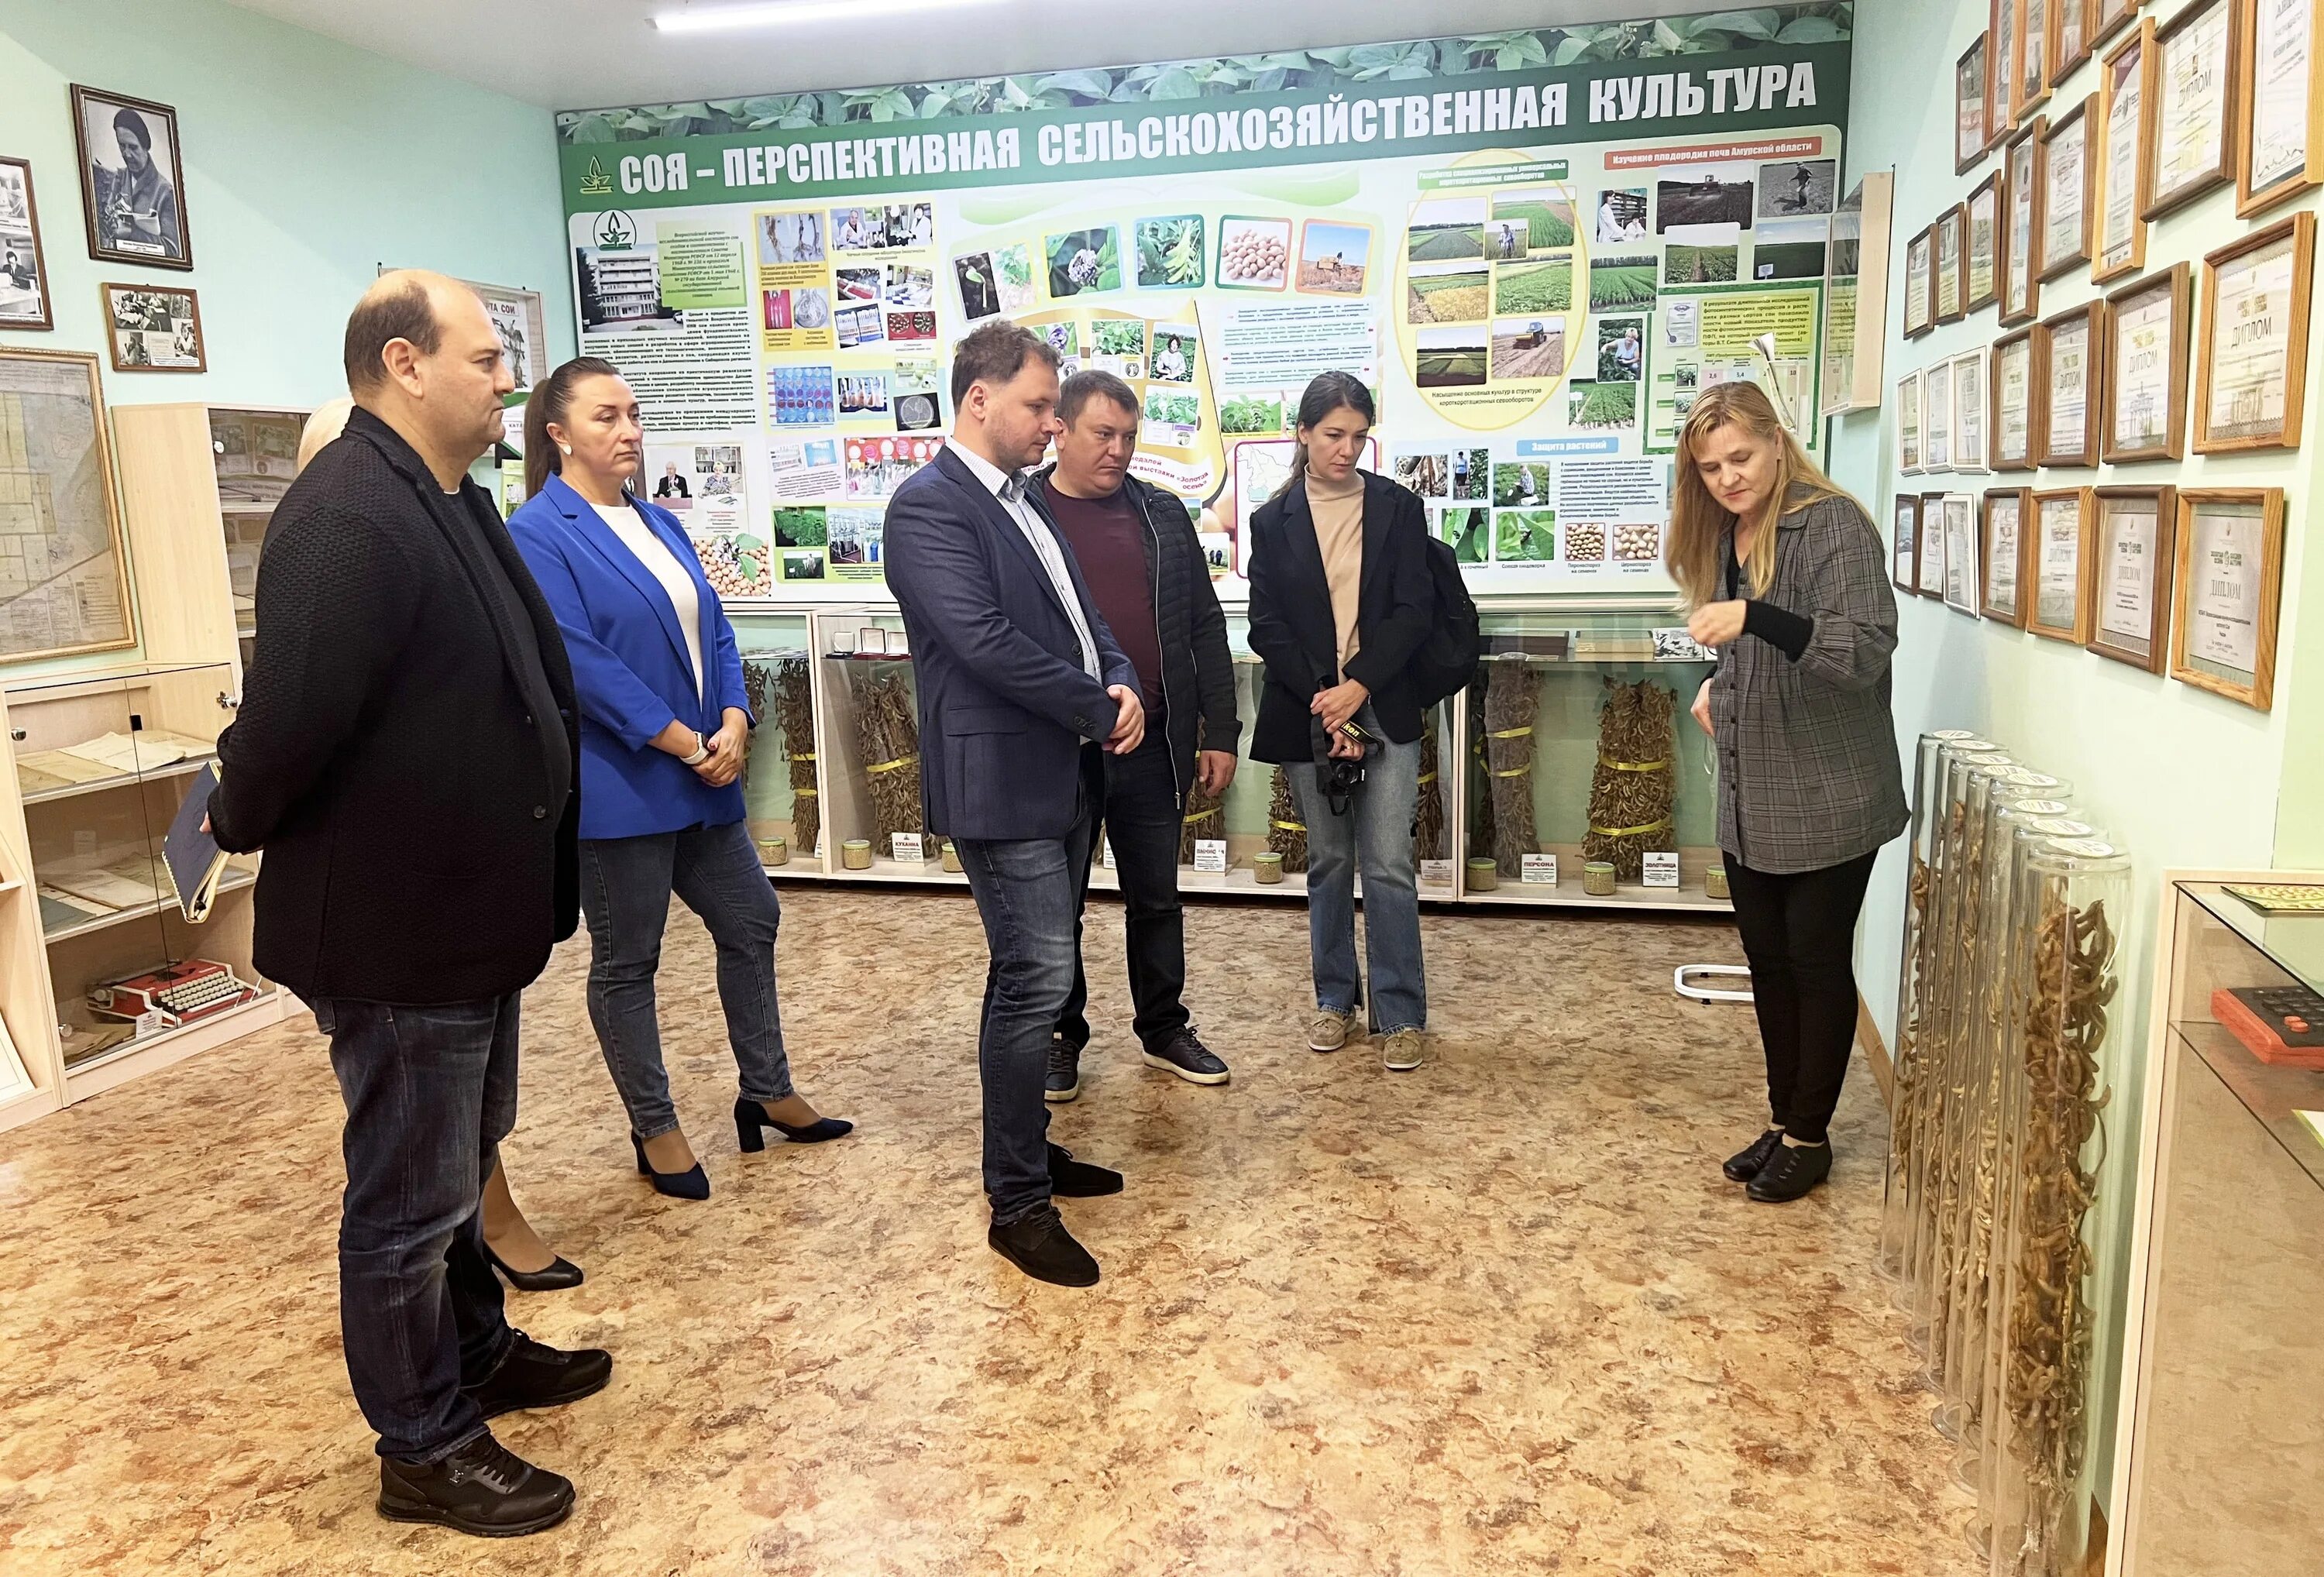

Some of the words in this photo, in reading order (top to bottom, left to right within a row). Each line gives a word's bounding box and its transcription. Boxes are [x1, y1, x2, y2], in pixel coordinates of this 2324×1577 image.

[620, 153, 688, 194] СОЯ
[723, 128, 1020, 187] ПЕРСПЕКТИВНАЯ
[1037, 82, 1567, 166] СЕЛЬСКОХОЗЯЙСТВЕННАЯ
[1589, 62, 1817, 122] КУЛЬТУРА
[1613, 154, 1652, 164] Изучение
[1655, 151, 1707, 162] плодородия
[1710, 149, 1729, 160] почв
[1731, 145, 1773, 156] Амурской
[1776, 142, 1811, 153] области
[501, 304, 515, 314] СОИ
[2231, 316, 2271, 349] ДИПЛОМ
[2129, 349, 2157, 376] ДИПЛОМ
[1532, 442, 1564, 452] Защита
[1566, 440, 1607, 451] растений
[1140, 466, 1174, 479] выставки
[2209, 579, 2241, 600] ДИПЛОМ
